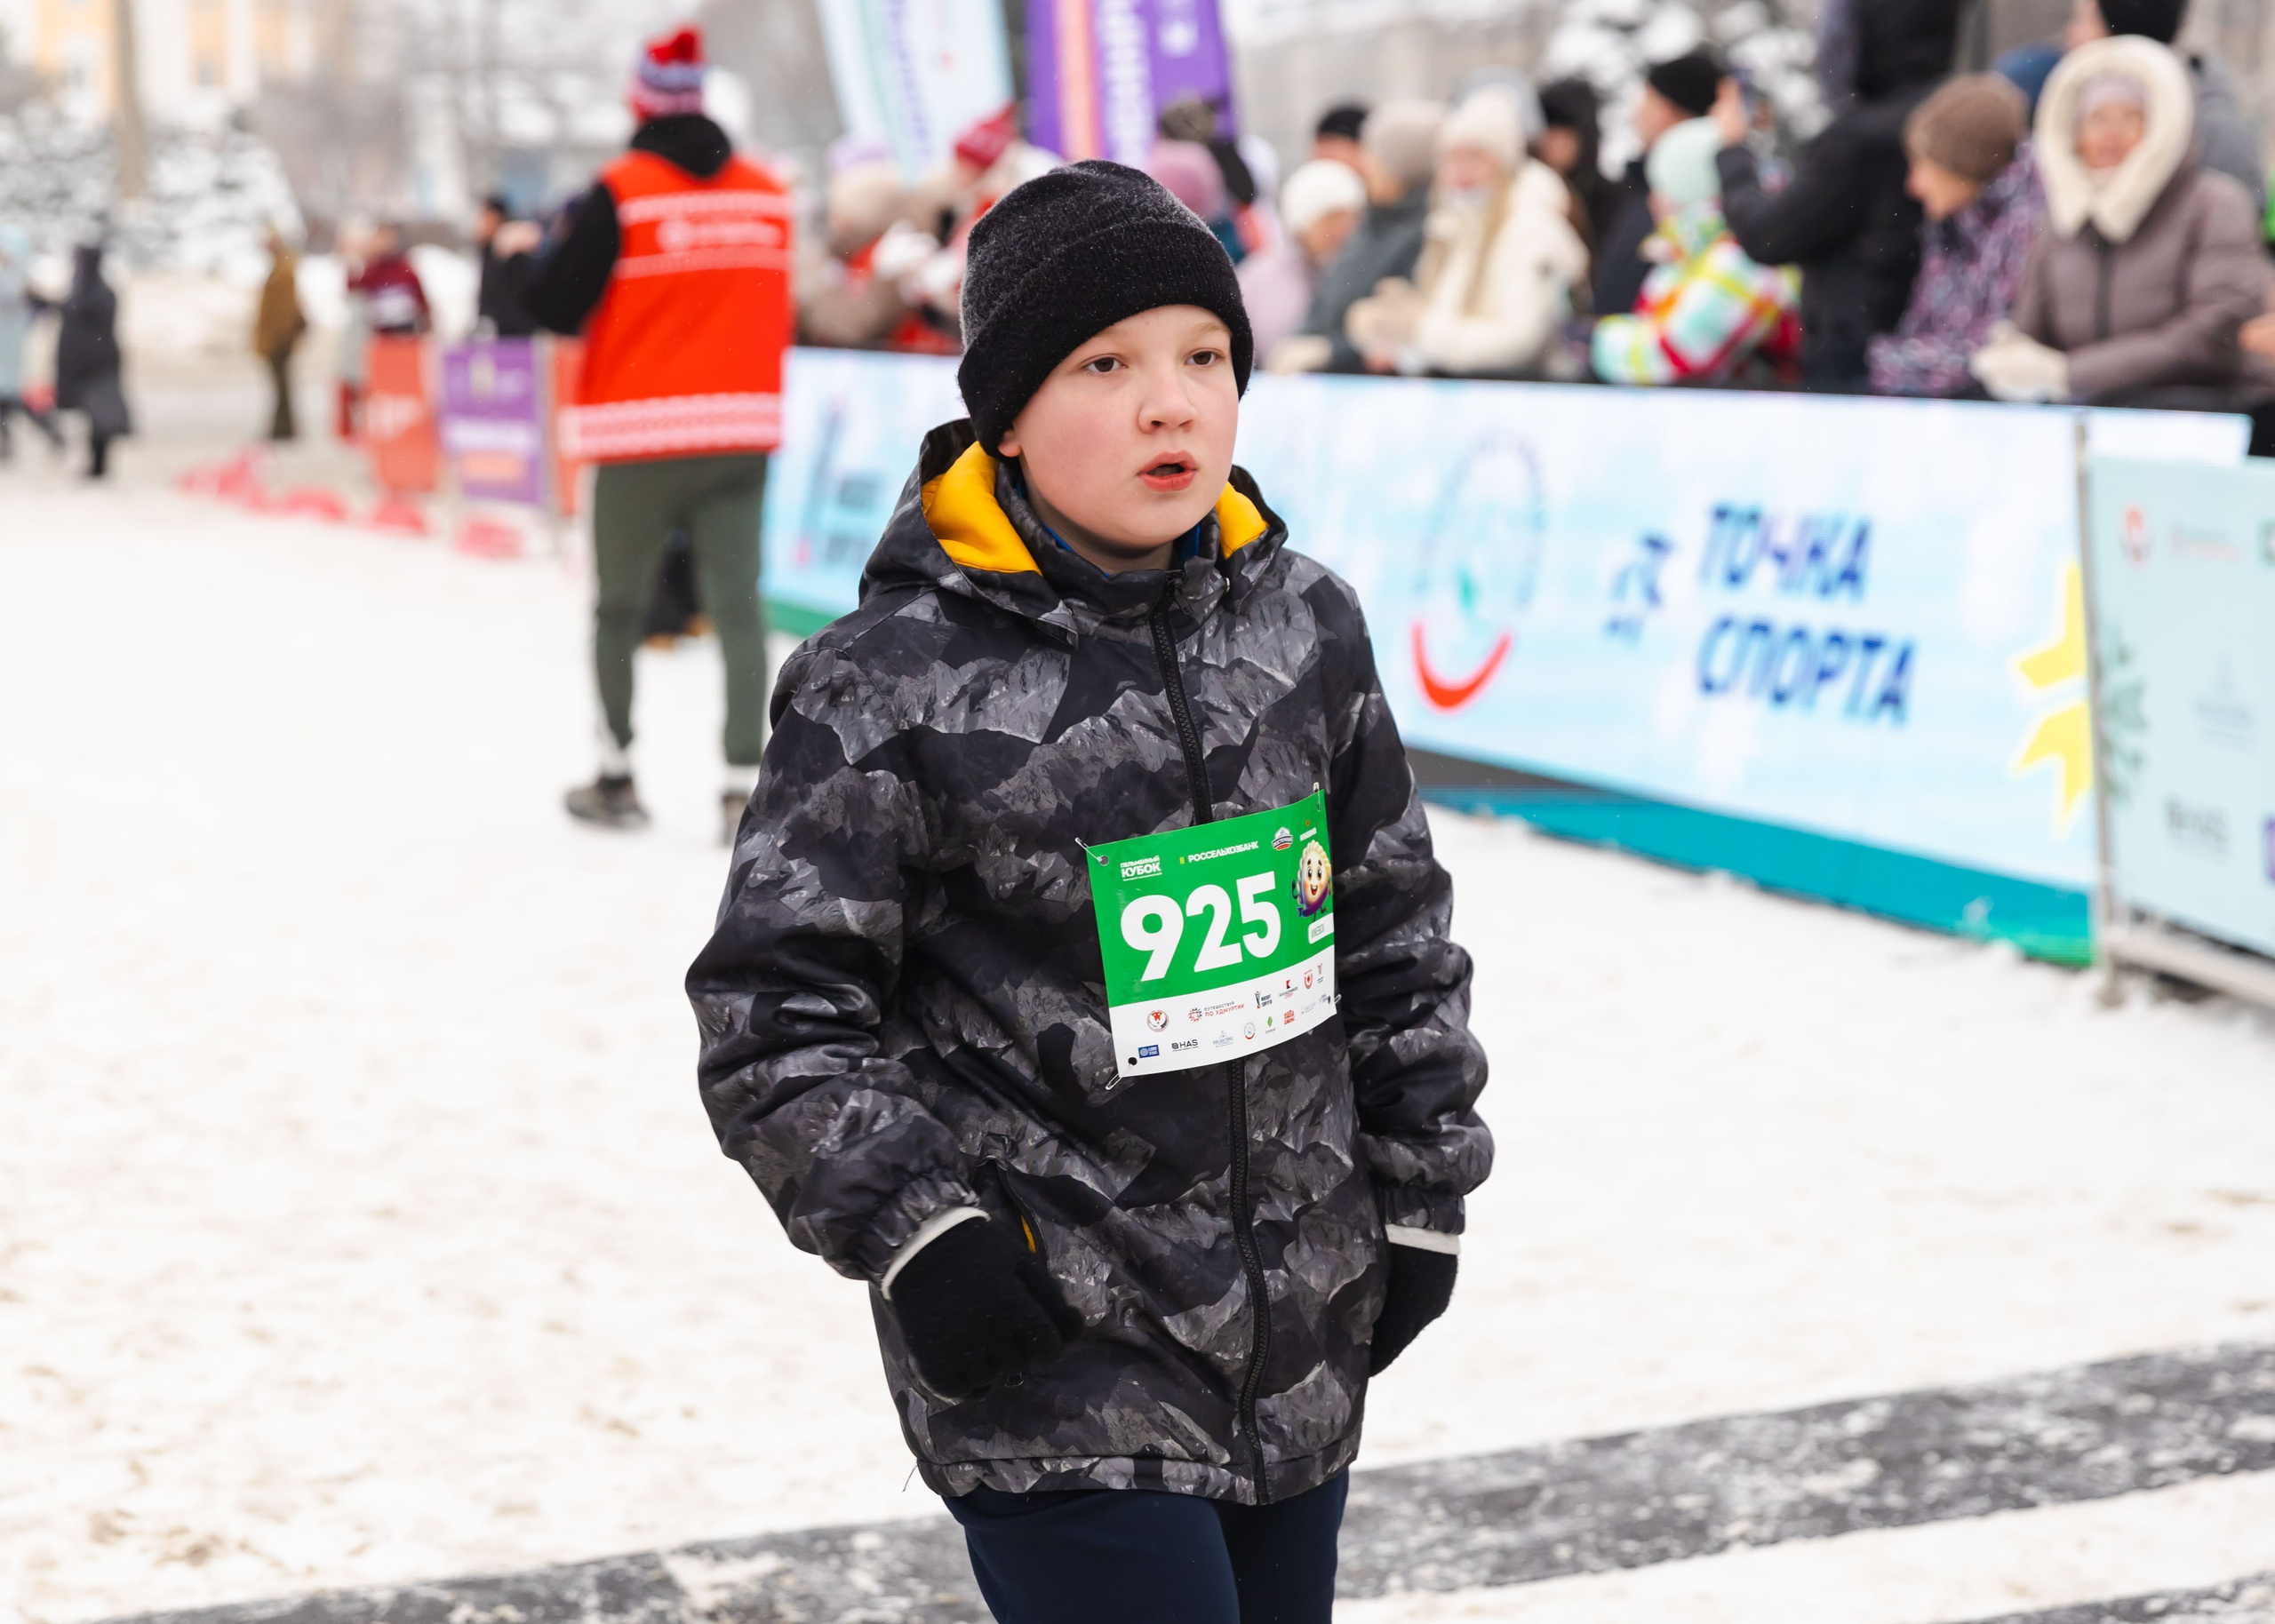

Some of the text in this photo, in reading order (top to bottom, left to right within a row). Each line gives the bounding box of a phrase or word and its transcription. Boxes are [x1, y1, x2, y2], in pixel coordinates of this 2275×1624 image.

[1701, 502, 1873, 602] ТОЧКА
[1698, 614, 1913, 724] СПОРТА
[1188, 841, 1258, 863] РОССЕЛЬХОЗБАНК
[1122, 863, 1161, 878] КУБОК
[1121, 871, 1281, 982] 925
[1204, 1001, 1234, 1011] ПУТЕШЕСТВУЙ
[1216, 1004, 1245, 1015] УДМУРТИИ
[1179, 1039, 1199, 1048] HAS
